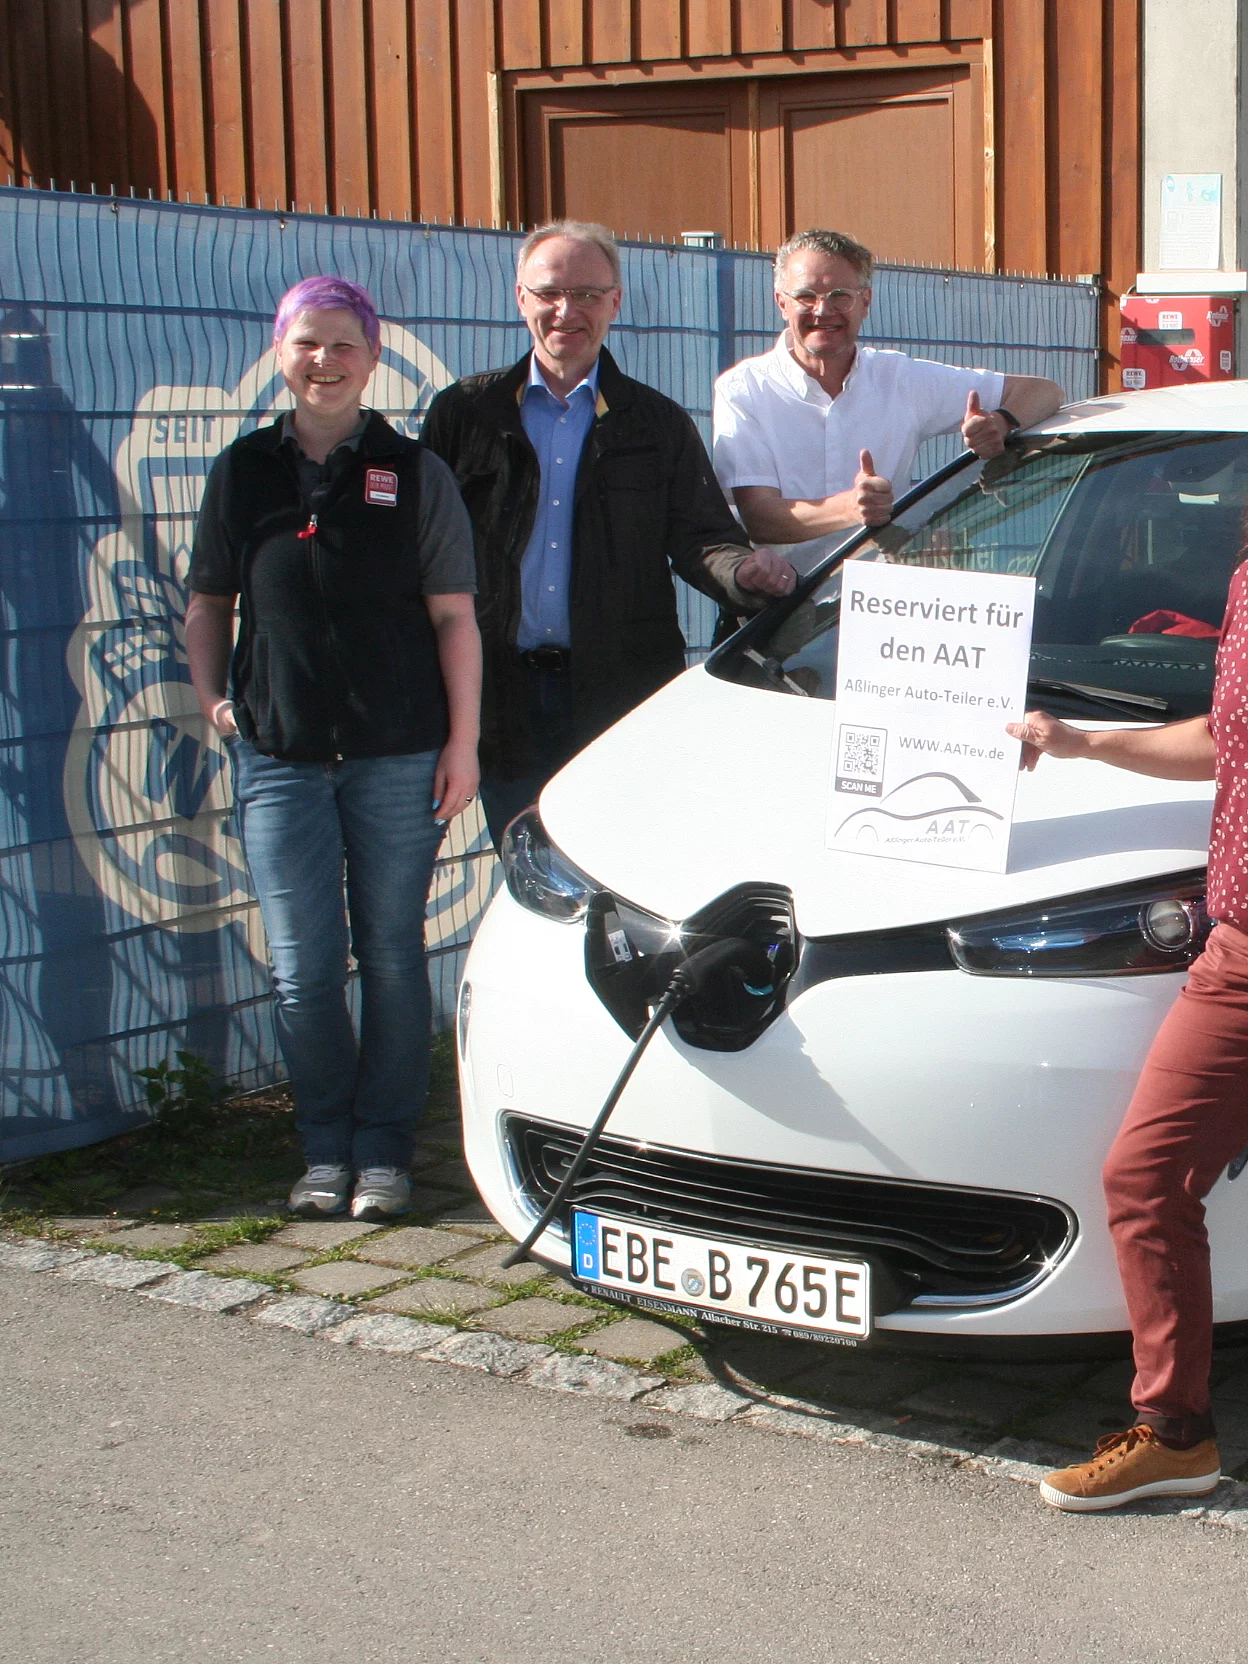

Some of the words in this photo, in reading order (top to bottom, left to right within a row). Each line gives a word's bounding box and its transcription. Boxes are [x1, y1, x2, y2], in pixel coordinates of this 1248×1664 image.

[152, 414, 217, 445] SEIT
[369, 473, 395, 484] REWE
[850, 590, 978, 624] Reserviert
[985, 602, 1024, 629] für
[880, 636, 926, 663] den
[932, 643, 987, 669] AAT
[844, 678, 902, 698] Aßlinger
[904, 685, 984, 706] Auto-Teiler
[986, 695, 1015, 711] e.V.
[841, 780, 864, 791] SCAN
[864, 782, 877, 794] ME
[925, 819, 971, 835] AAT
[583, 1253, 594, 1269] D
[600, 1225, 676, 1291] EBE
[708, 1249, 733, 1301] B
[746, 1255, 862, 1325] 765E
[591, 1284, 632, 1304] RENAULT
[636, 1297, 699, 1318] EISENMANN
[701, 1310, 741, 1328] Allacher
[743, 1320, 761, 1331] Str.
[761, 1323, 779, 1335] 215
